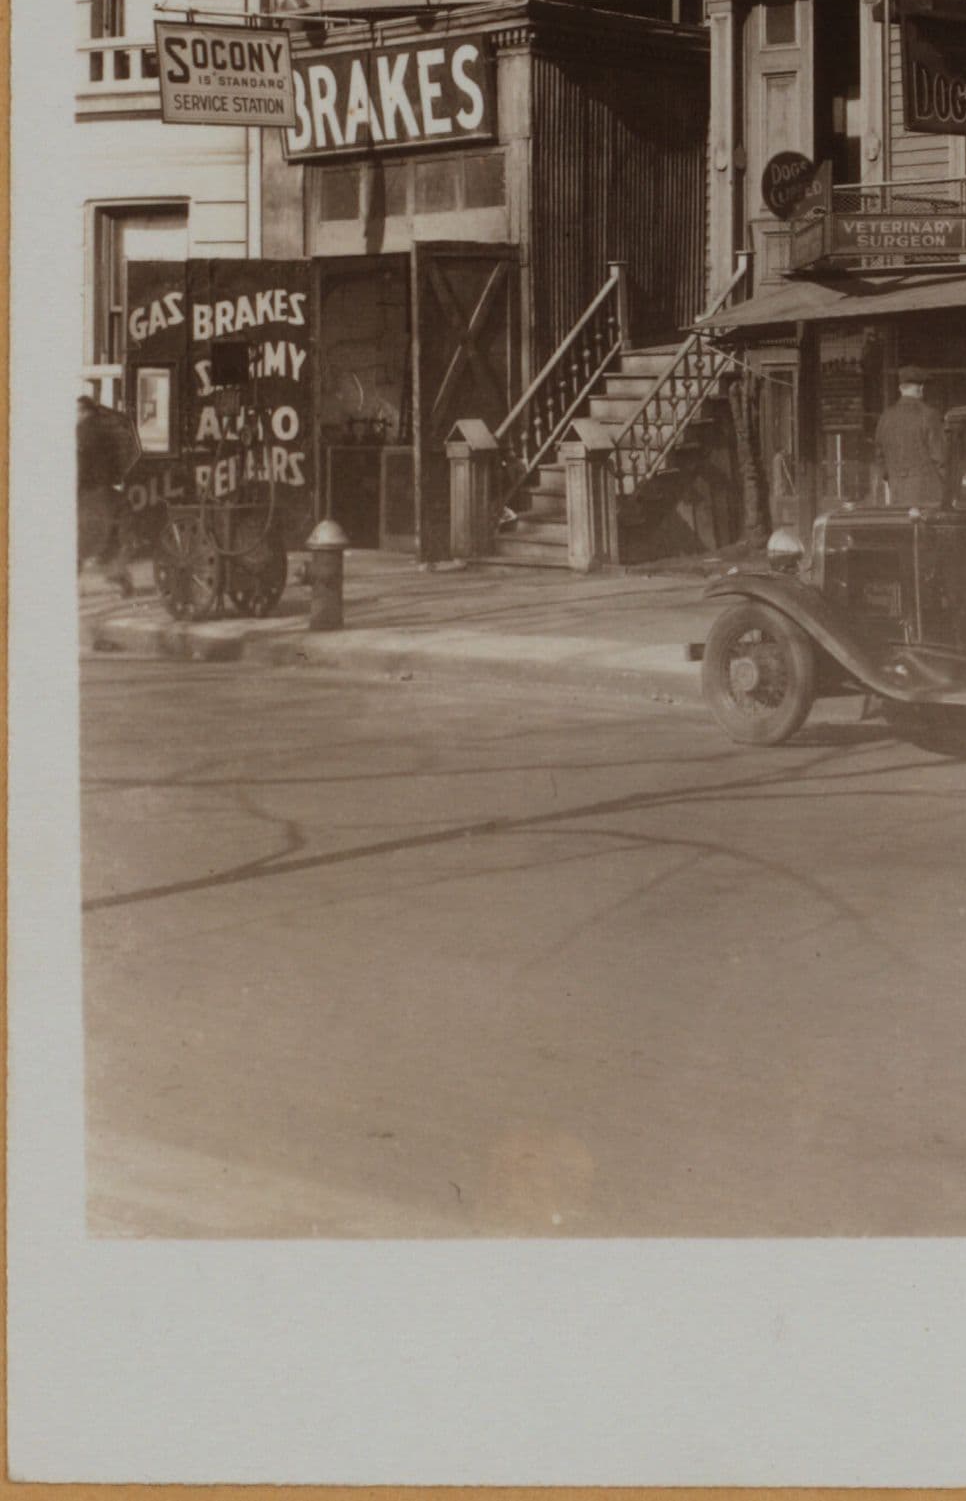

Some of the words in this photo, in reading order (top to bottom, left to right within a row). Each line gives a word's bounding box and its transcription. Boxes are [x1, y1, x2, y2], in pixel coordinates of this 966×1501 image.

[164, 36, 283, 84] SOCONY
[173, 93, 230, 113] SERVICE
[232, 96, 285, 115] STATION
[286, 44, 484, 151] BRAKES
[843, 220, 954, 234] VETERINARY
[856, 235, 945, 248] SURGEON
[129, 291, 184, 341] GAS
[193, 289, 306, 341] BRAKES
[127, 468, 185, 512] OIL
